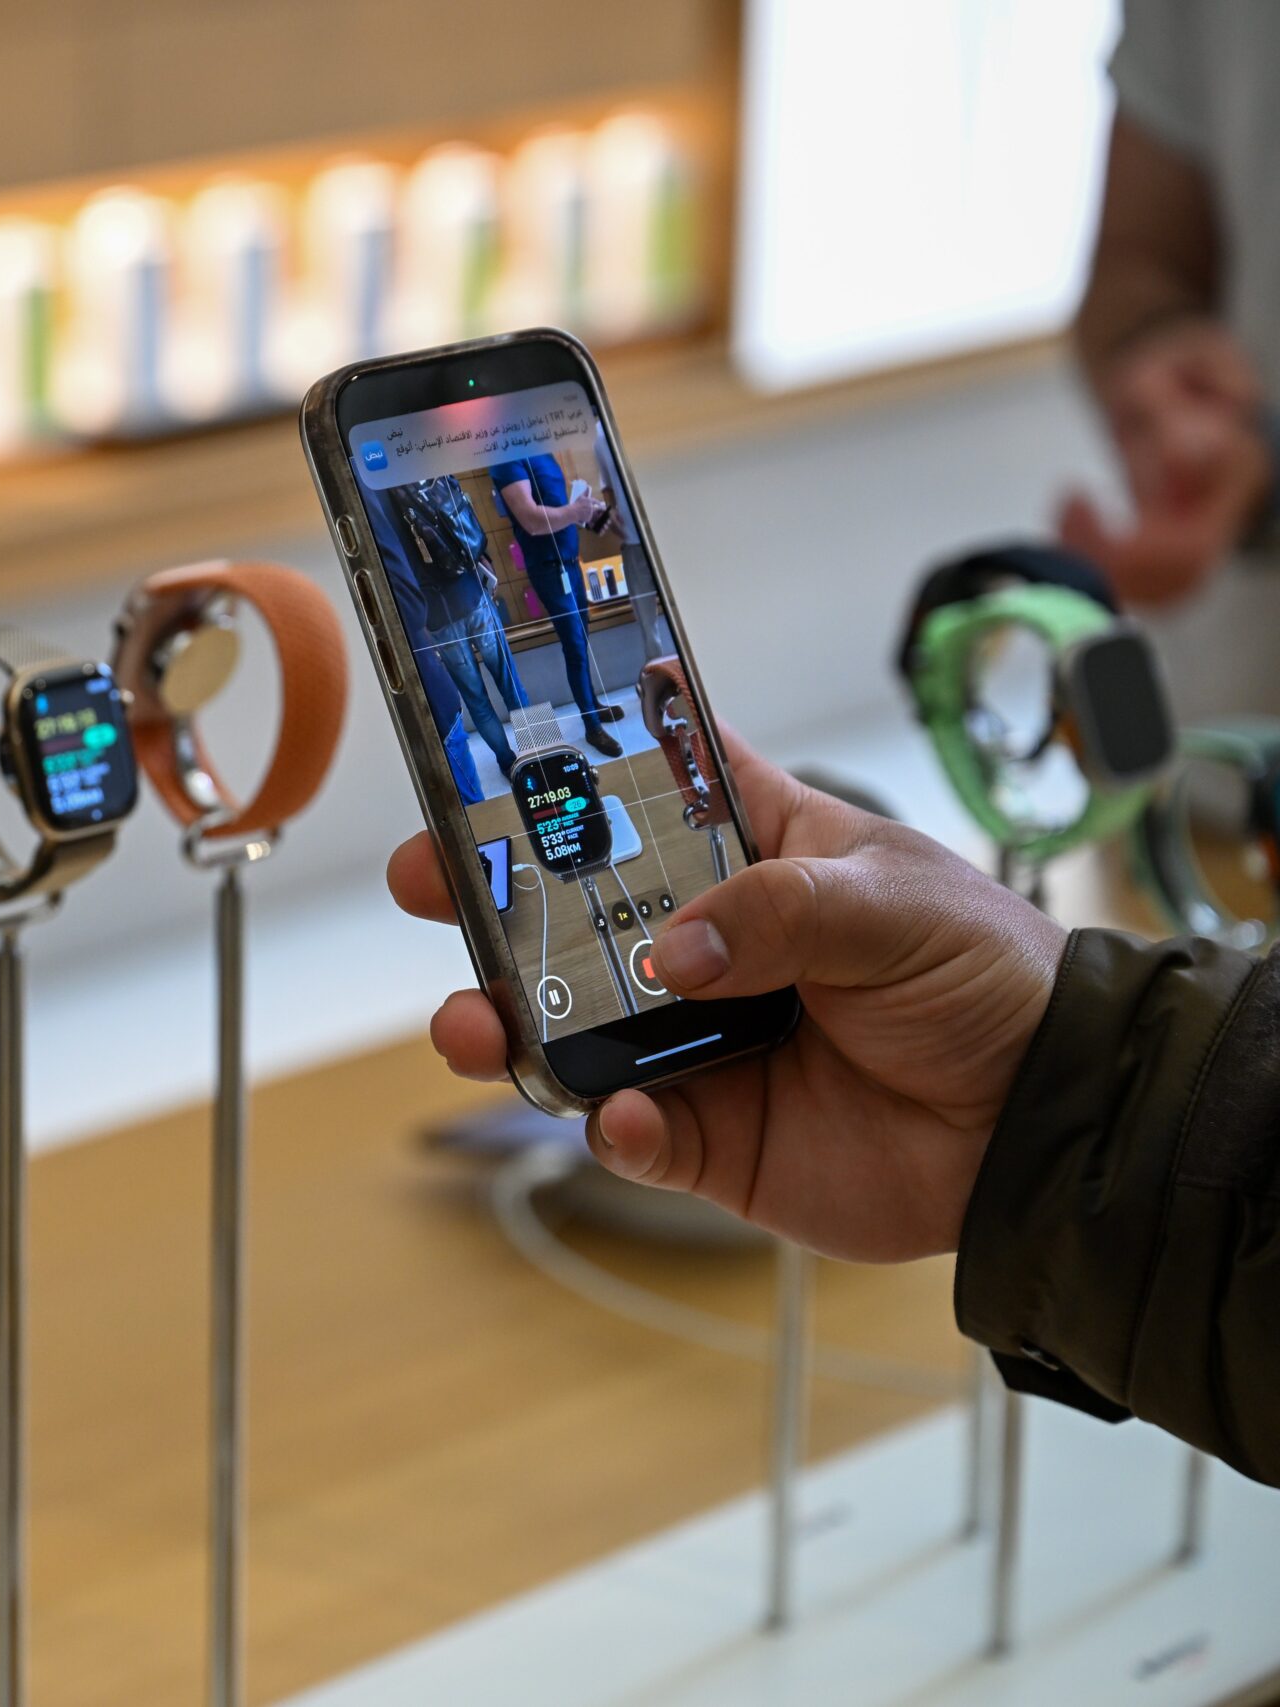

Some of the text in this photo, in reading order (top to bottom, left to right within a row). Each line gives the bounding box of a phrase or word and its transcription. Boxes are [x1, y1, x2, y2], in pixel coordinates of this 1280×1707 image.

[365, 449, 384, 461] نبض
[528, 787, 572, 808] 27:19.03
[546, 843, 581, 860] 5.08KM
[642, 906, 648, 914] 2
